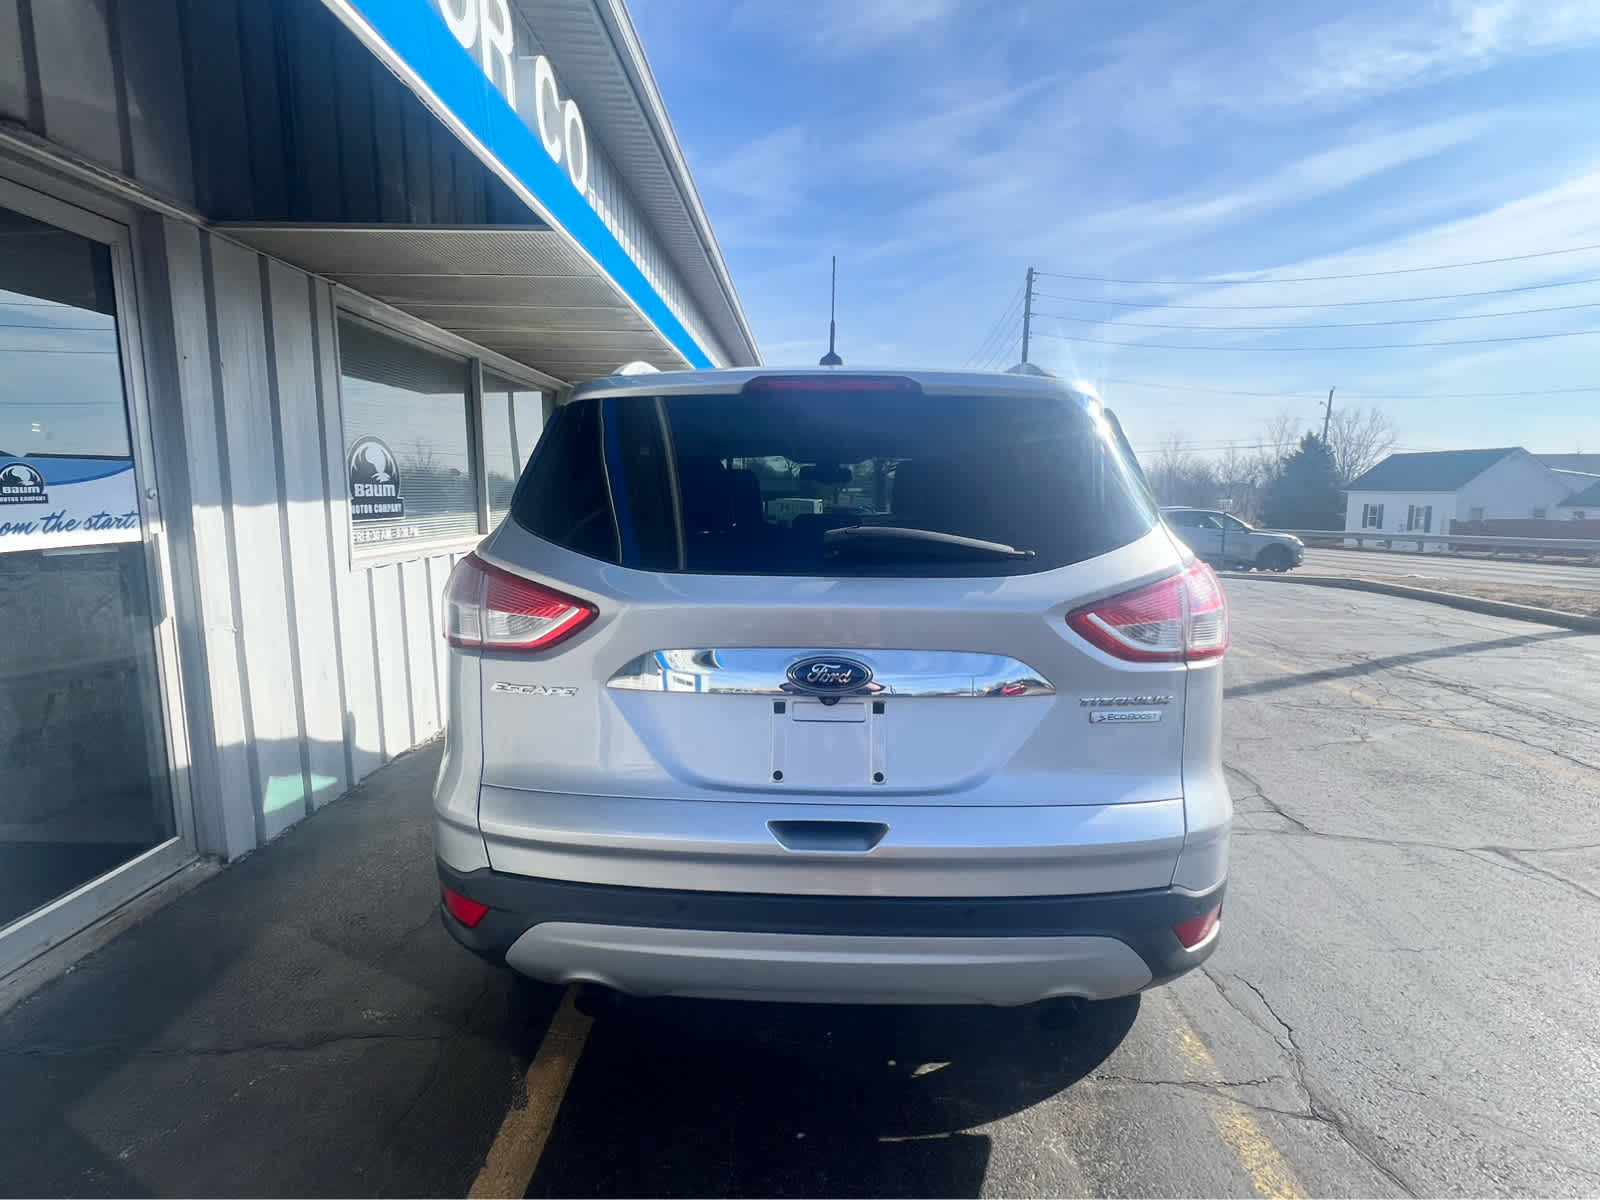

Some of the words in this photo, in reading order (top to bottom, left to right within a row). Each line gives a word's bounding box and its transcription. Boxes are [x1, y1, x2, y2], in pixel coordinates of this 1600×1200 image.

[40, 509, 82, 532] the
[83, 510, 139, 531] start.
[806, 663, 853, 683] Ford
